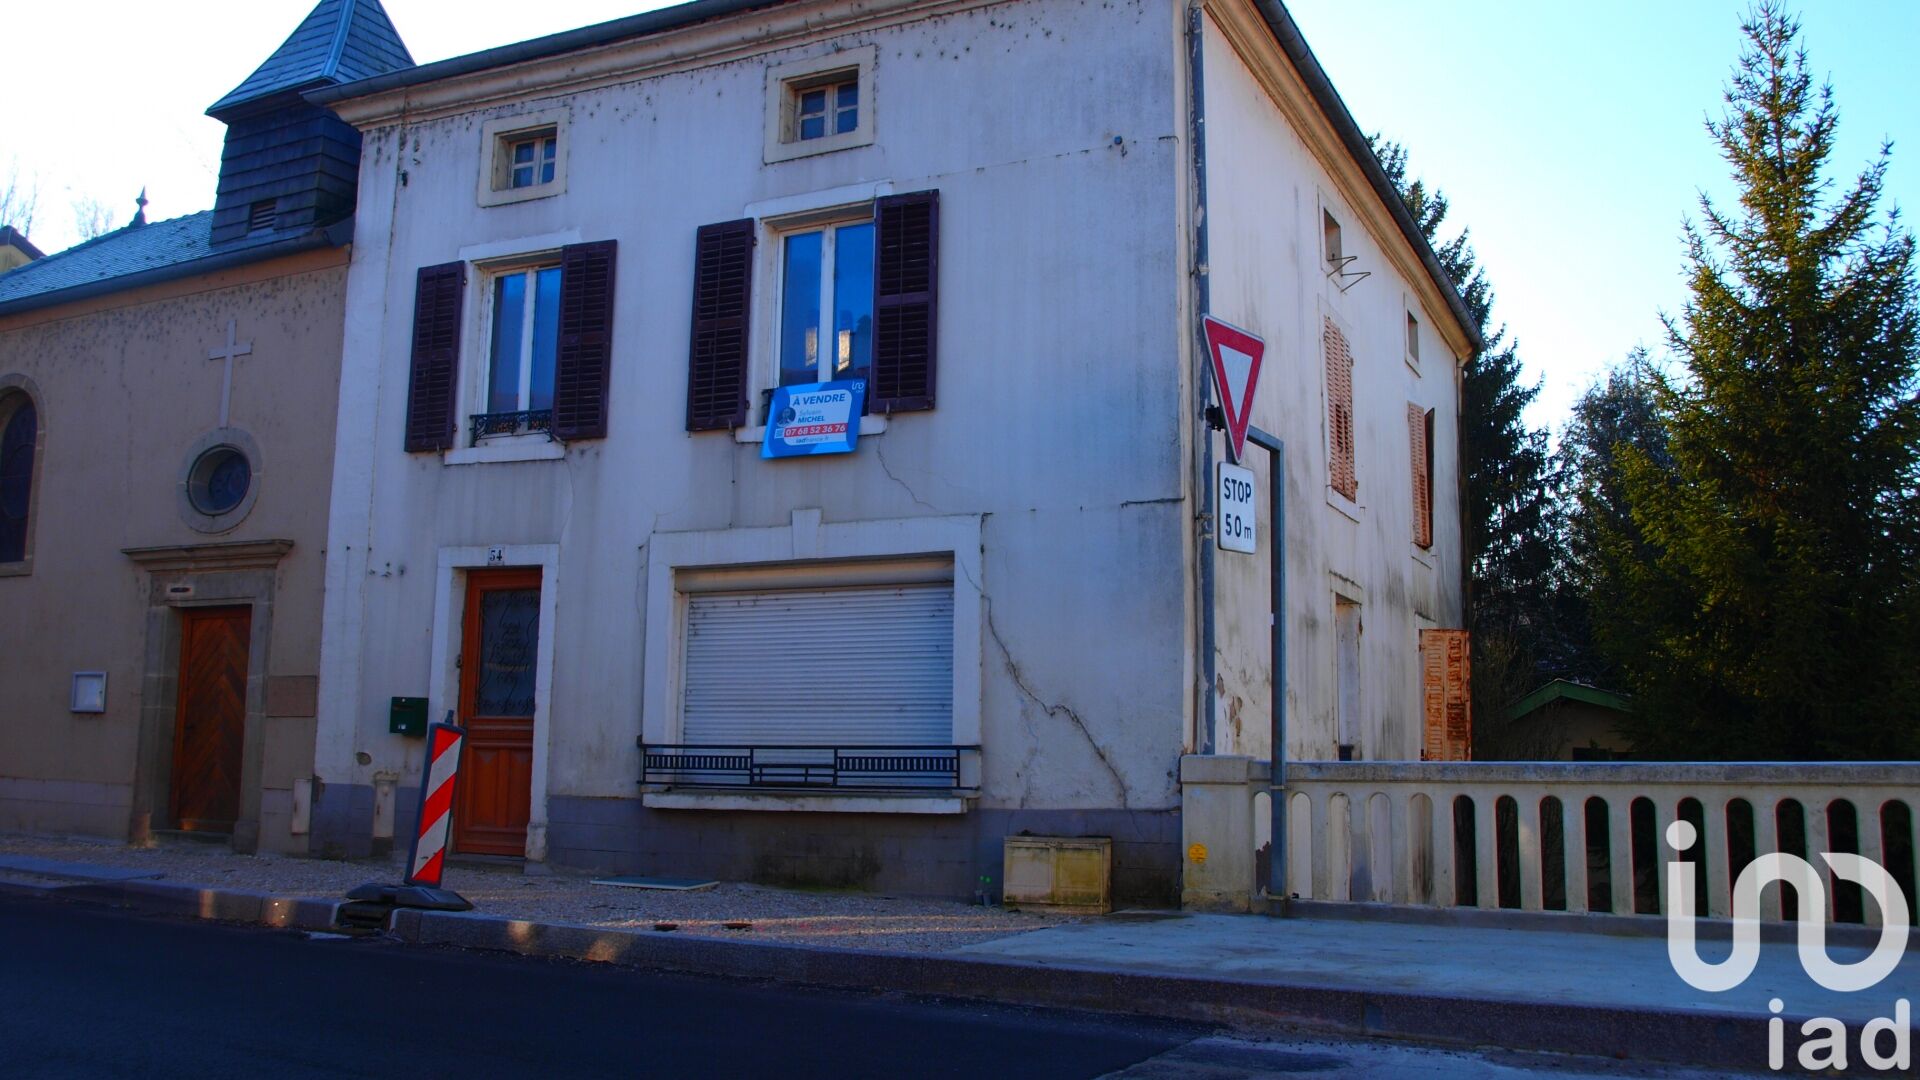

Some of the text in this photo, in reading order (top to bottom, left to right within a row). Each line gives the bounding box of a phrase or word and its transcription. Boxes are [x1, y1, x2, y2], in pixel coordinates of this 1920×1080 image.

[803, 393, 846, 405] VENDRE
[798, 415, 825, 424] MICHEL
[785, 428, 797, 436] 07
[810, 426, 821, 434] 52
[822, 425, 833, 433] 36
[835, 424, 846, 432] 76
[1223, 477, 1252, 504] STOP
[489, 549, 503, 561] 54
